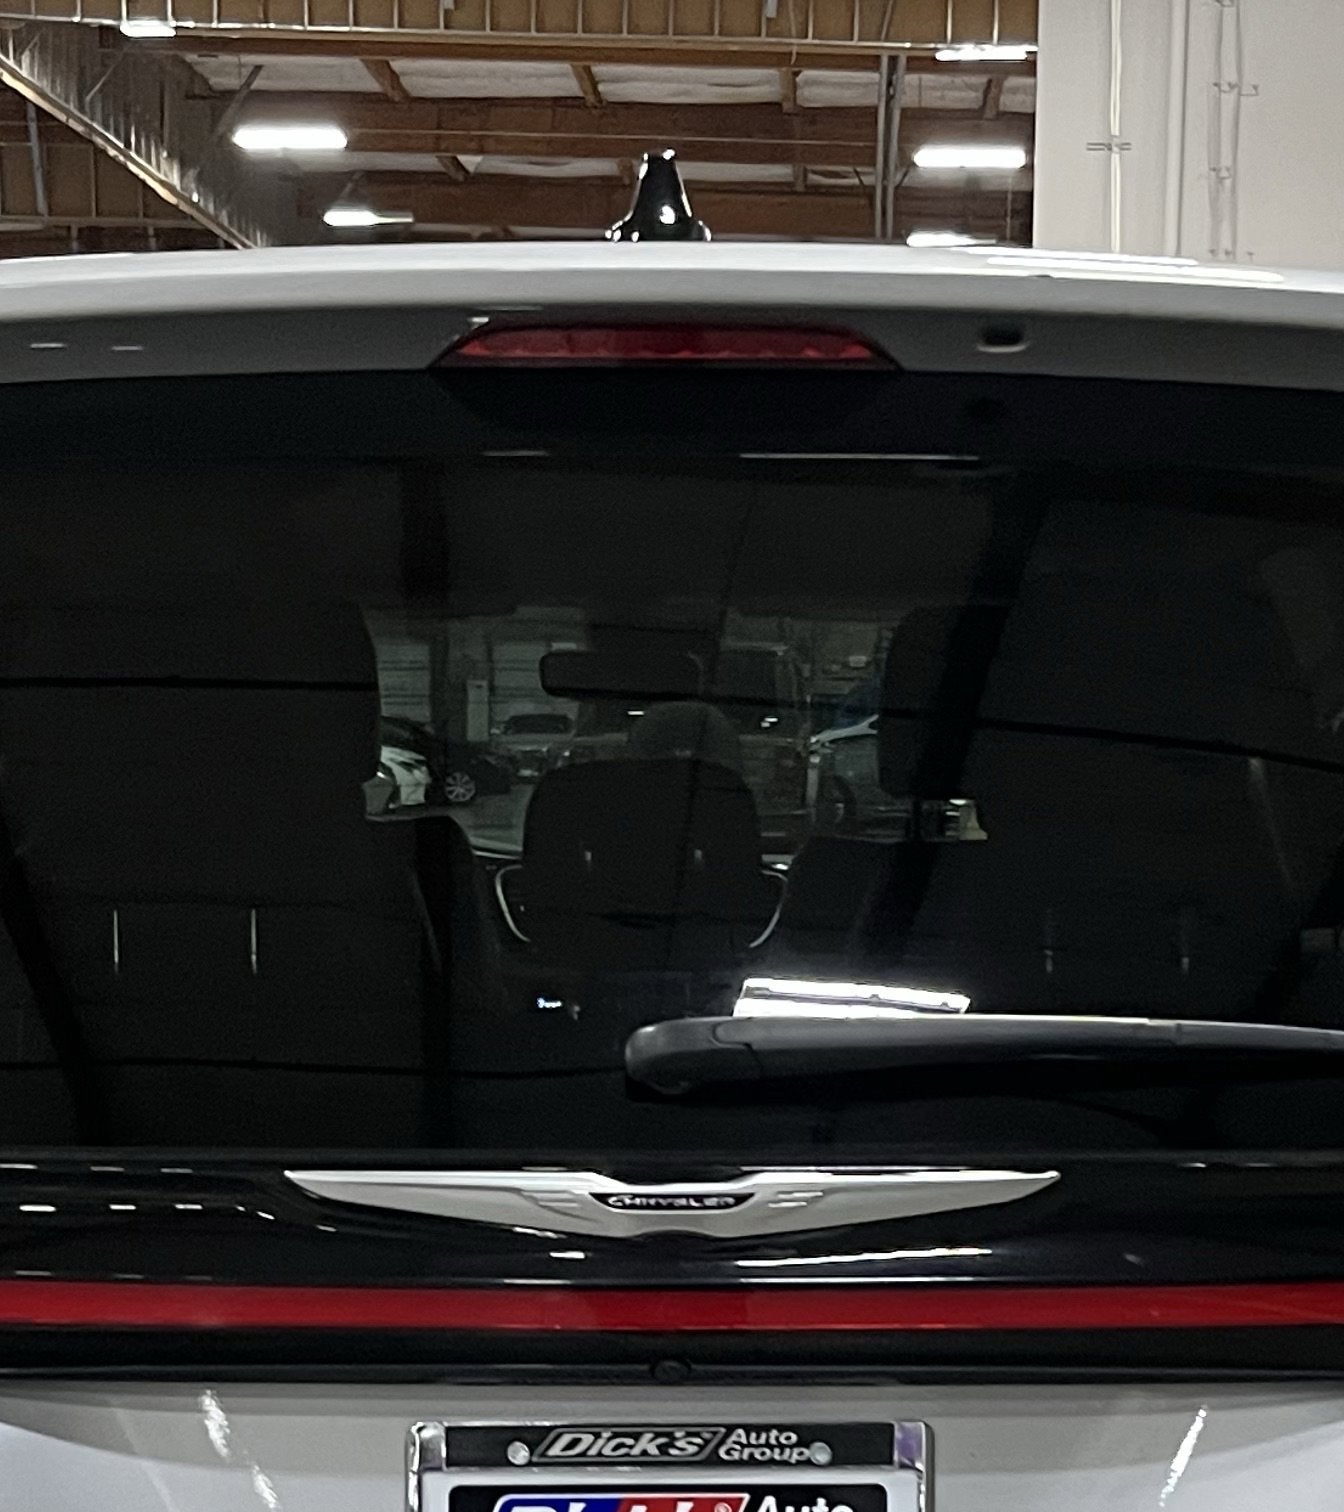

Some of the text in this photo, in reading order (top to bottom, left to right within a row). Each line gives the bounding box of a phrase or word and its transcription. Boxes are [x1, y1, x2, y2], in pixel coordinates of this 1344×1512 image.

[545, 1428, 705, 1458] Dick's
[721, 1428, 798, 1446] Auto
[719, 1444, 811, 1463] Group
